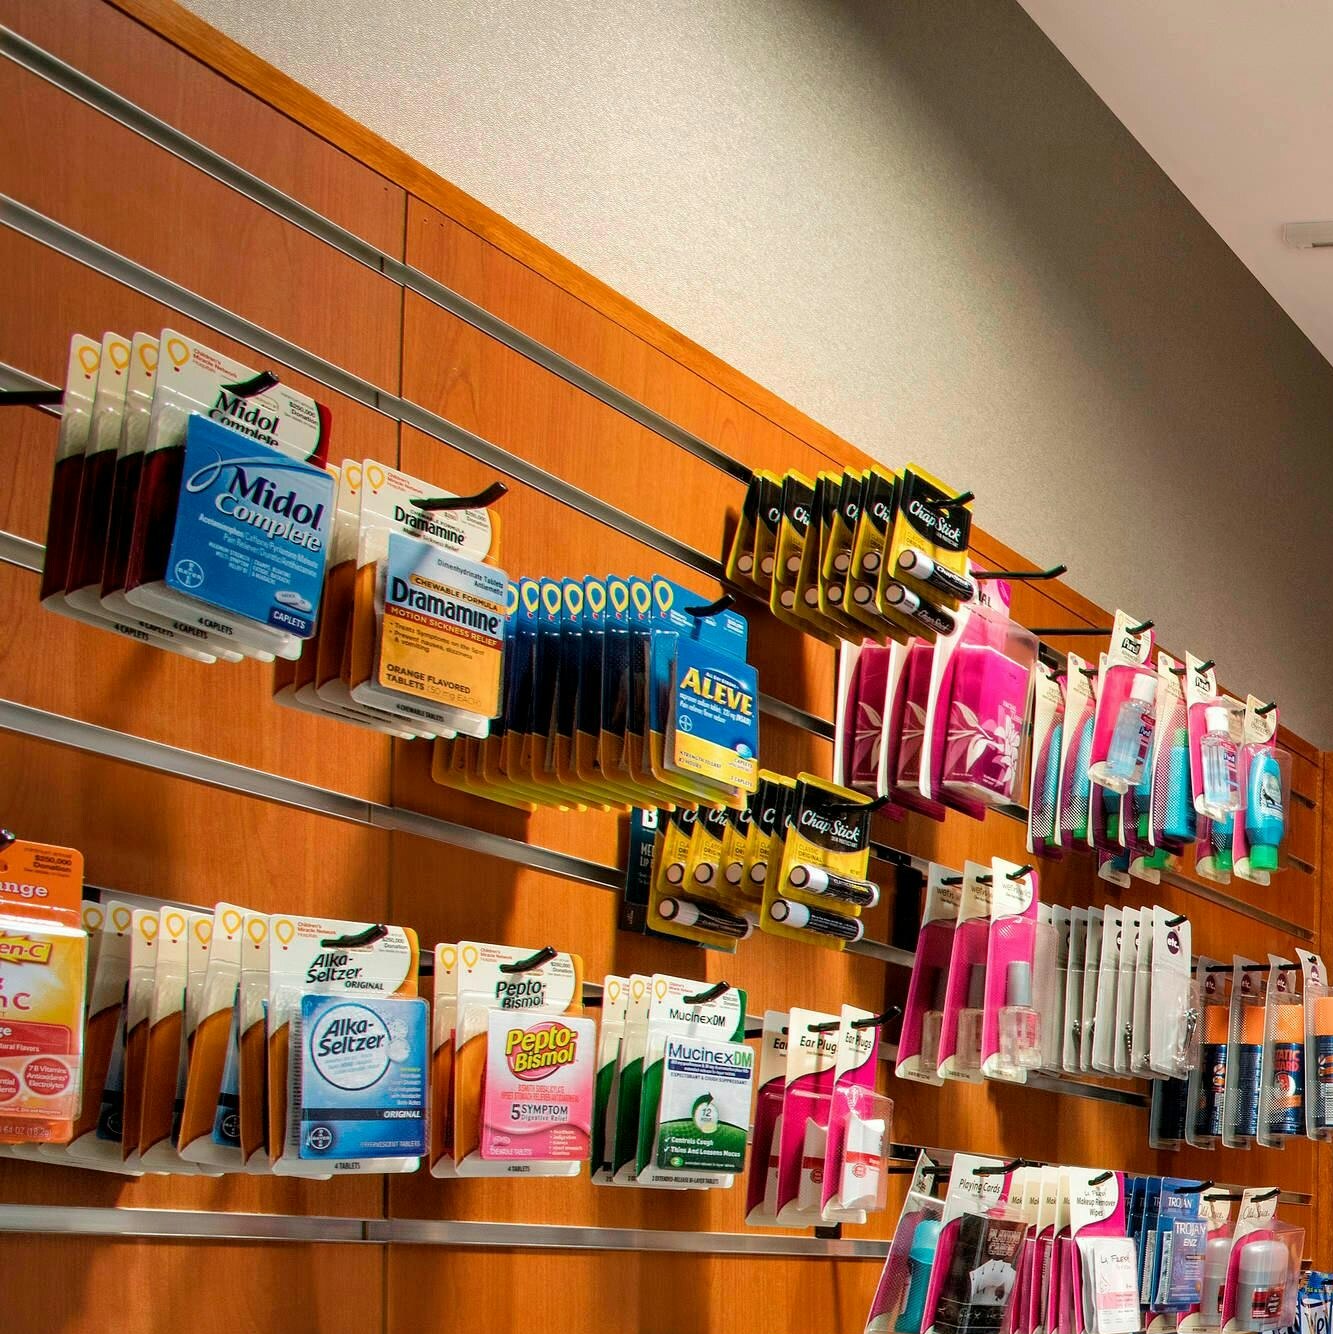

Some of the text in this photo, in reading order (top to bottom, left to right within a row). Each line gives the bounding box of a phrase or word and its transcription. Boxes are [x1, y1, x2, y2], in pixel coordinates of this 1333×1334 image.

[215, 390, 280, 434] Midol
[228, 465, 324, 531] Midol
[215, 493, 322, 552] Complete
[394, 505, 465, 546] Dramamine
[414, 577, 498, 612] CHEWABLE FORMULA
[391, 576, 500, 635] Dramamine
[205, 618, 233, 635] CAPLETS
[273, 611, 306, 630] CAPLETS
[391, 606, 498, 647] MOTION SICKNESS RELIEF
[387, 663, 471, 694] ORANGE FLAVORED
[387, 673, 425, 691] TABLETS
[680, 666, 753, 717] ALEVE
[311, 953, 353, 969] Alka-
[306, 966, 361, 984] Seltzer
[345, 980, 385, 991] ORIGINAL
[496, 981, 547, 999] Pepto-
[323, 1018, 374, 1039] Alka-
[318, 1033, 386, 1057] Seltzer
[506, 1026, 578, 1055] Pepto-
[800, 1036, 815, 1048] Ear
[856, 1034, 872, 1049] Plugs
[514, 1048, 575, 1073] Bismol
[383, 1110, 421, 1119] ORIGINAL
[511, 1104, 568, 1120] 5 SYMPTOM
[339, 1162, 361, 1170] TABLETS
[958, 1178, 1000, 1194] Playing Cards
[1168, 1196, 1192, 1208] TROJAN
[1176, 1223, 1207, 1236] TROJAN
